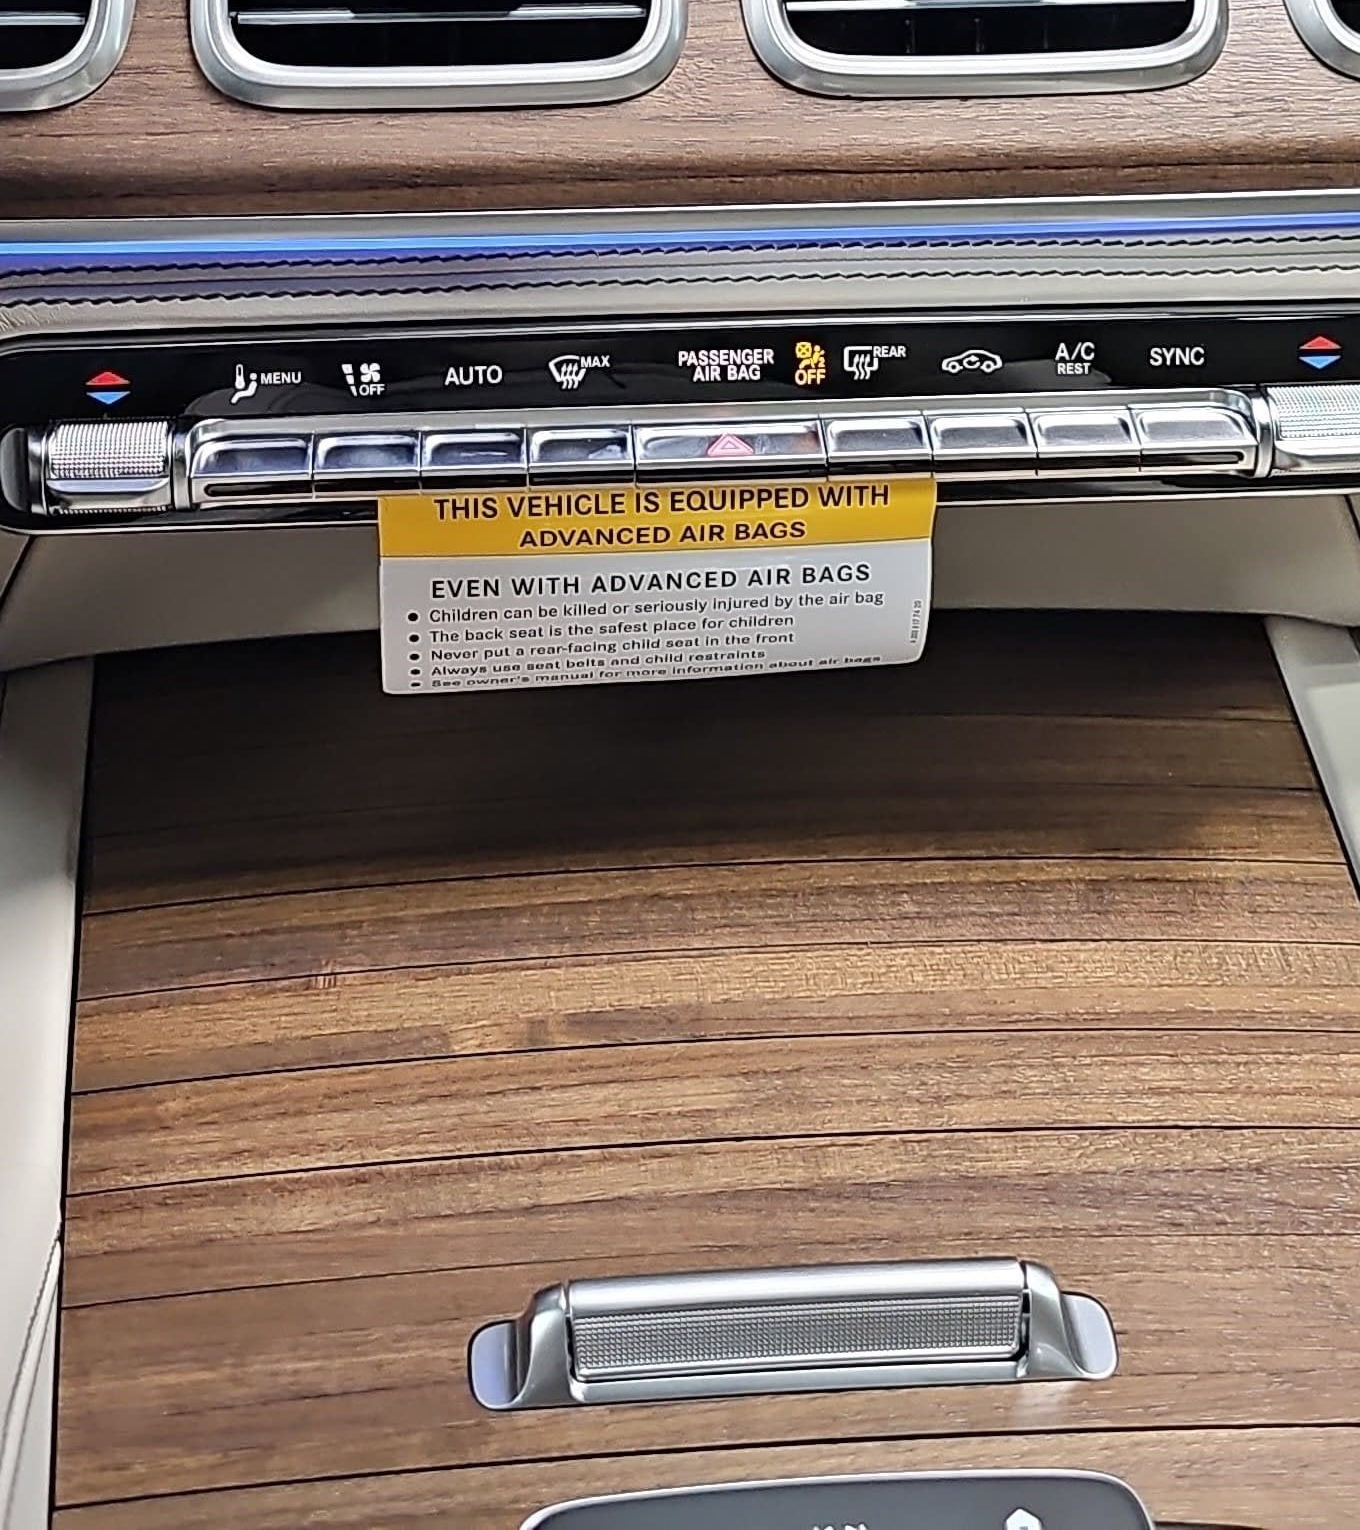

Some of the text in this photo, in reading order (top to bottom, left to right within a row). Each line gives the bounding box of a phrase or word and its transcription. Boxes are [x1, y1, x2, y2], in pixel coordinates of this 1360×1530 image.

[678, 348, 775, 367] PASSENGER
[873, 345, 907, 358] REAR
[1055, 341, 1095, 361] A/C
[1149, 346, 1205, 366] SYNC
[580, 355, 610, 369] MAX
[1057, 362, 1091, 375] REST
[260, 371, 302, 385] MENU
[444, 365, 503, 387] AUTO
[693, 364, 761, 382] AIR BAG
[794, 368, 826, 386] OFF
[359, 384, 386, 397] OFF
[434, 485, 890, 520] THIS VEHICLE IS EQUIPPED WITH
[520, 521, 807, 547] ADVANCED AIR BAGS
[432, 564, 871, 599] EVEN WITH ADVANCED AIR BAGS
[429, 590, 884, 623] Children can be killed or seriously injured by the air bag
[429, 615, 794, 643] The back seat is the safest place for children
[431, 631, 795, 661] Never put a rear-facing child seat in the front
[431, 650, 766, 679] Always use seat belts and child restraints
[535, 672, 594, 682] manual
[599, 670, 622, 678] for
[672, 663, 764, 675] information
[769, 660, 813, 668] about
